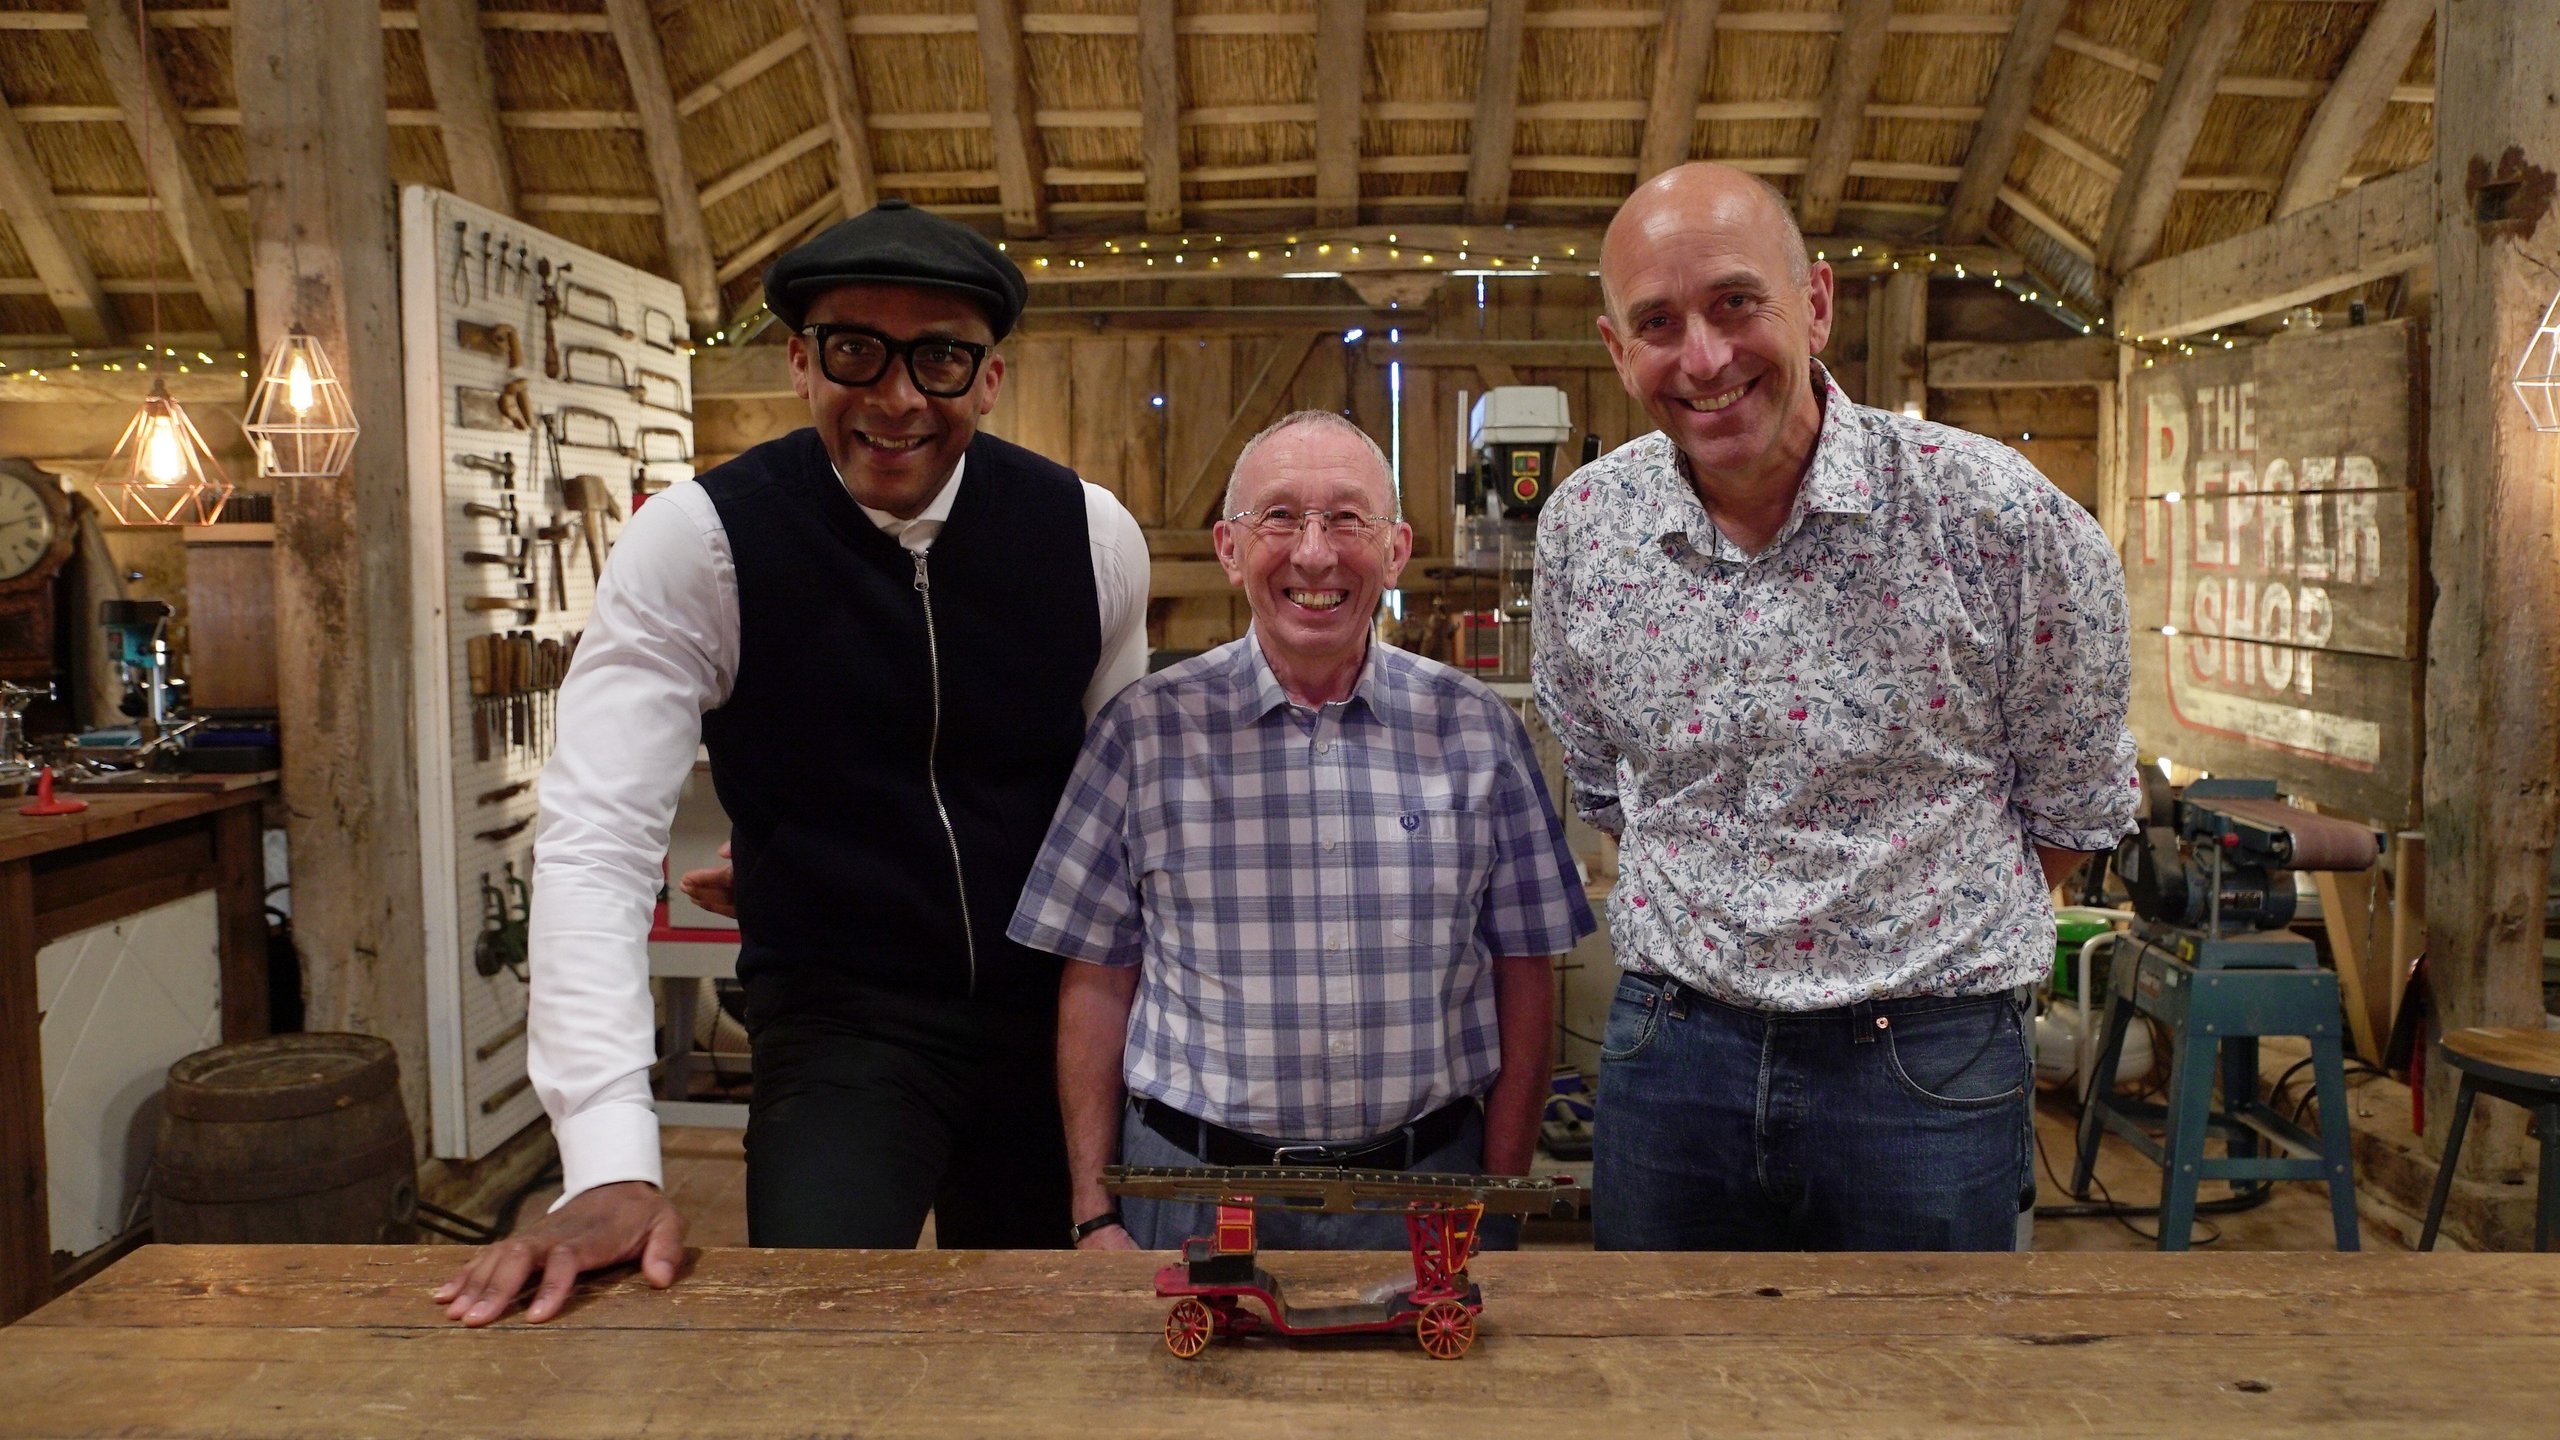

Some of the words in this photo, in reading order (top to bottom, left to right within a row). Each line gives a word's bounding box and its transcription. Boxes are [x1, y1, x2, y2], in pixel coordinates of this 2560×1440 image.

[2197, 383, 2258, 451] THE
[2142, 393, 2381, 588] REPAIR
[2190, 575, 2333, 697] SHOP
